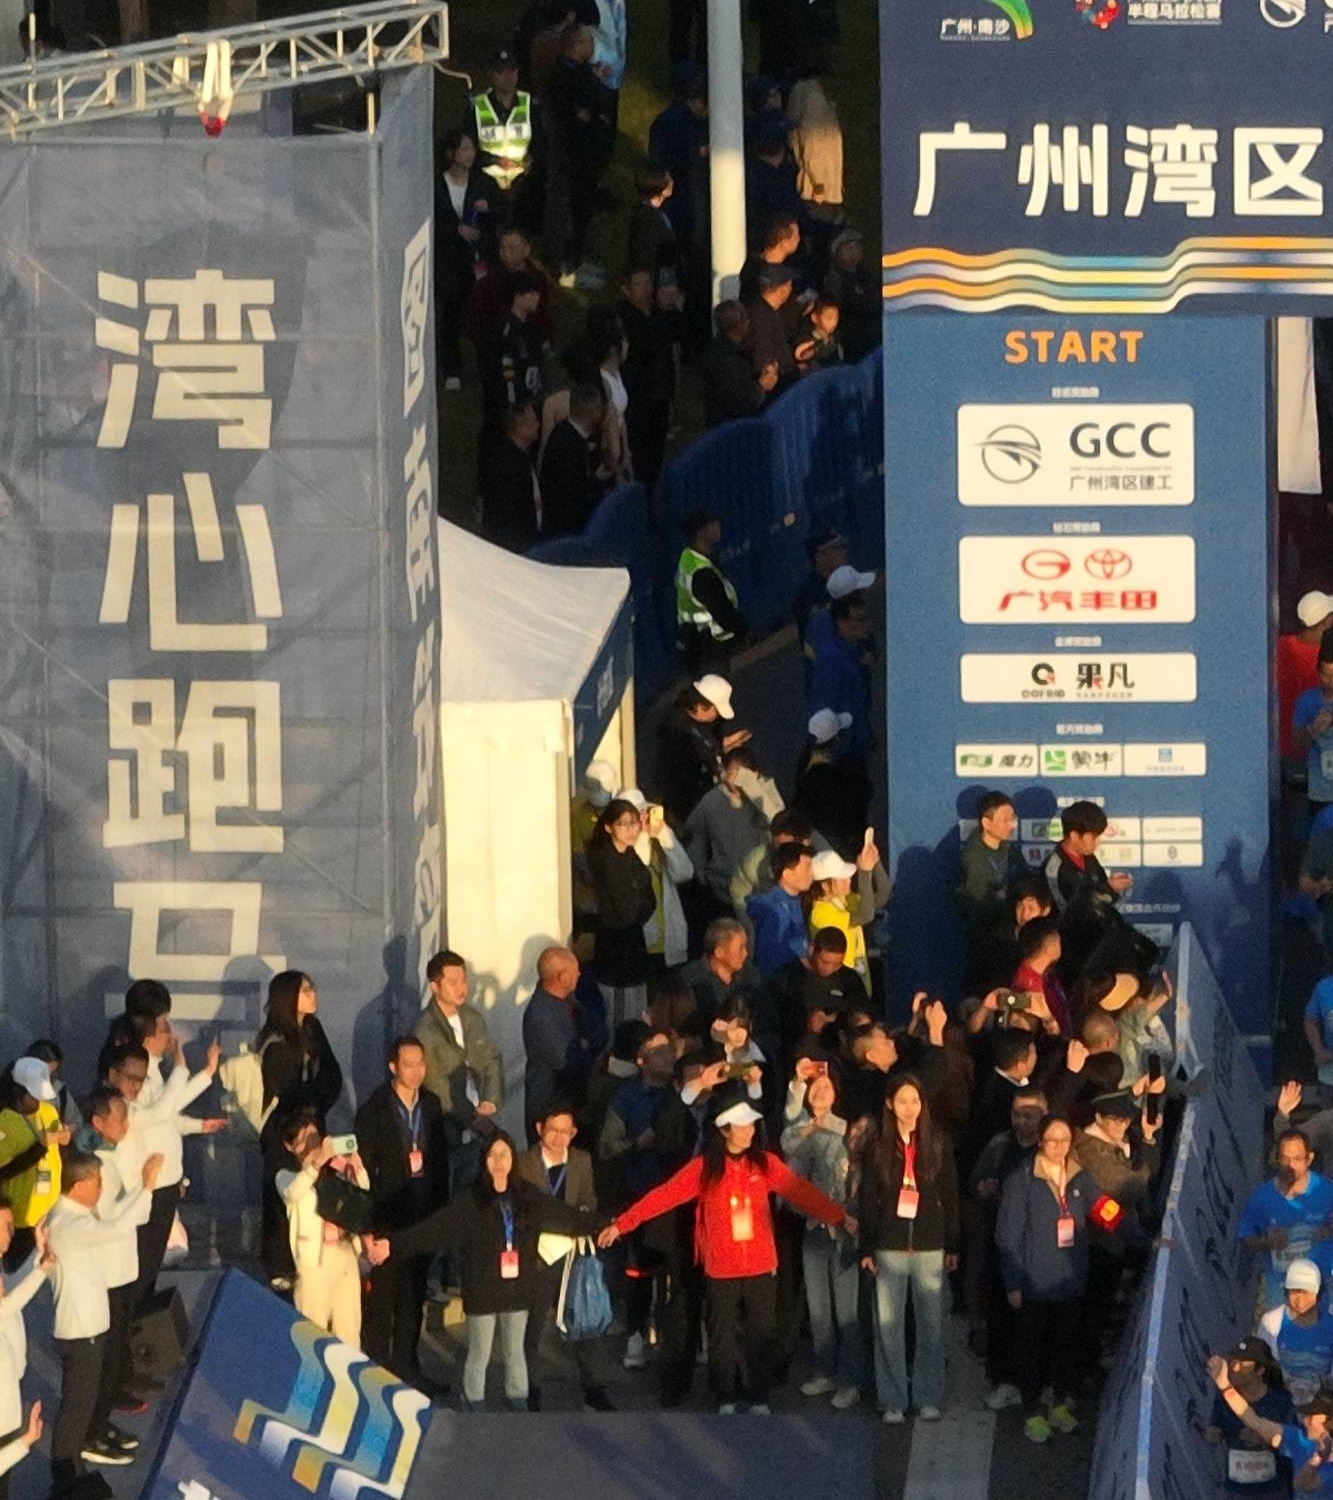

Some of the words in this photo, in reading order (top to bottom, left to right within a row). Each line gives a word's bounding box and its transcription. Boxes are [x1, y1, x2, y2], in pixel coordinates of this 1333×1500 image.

[1004, 329, 1144, 364] START
[1069, 422, 1172, 458] GCC
[1069, 474, 1173, 491] 广州湾区建工
[998, 589, 1158, 611] 广汽丰田
